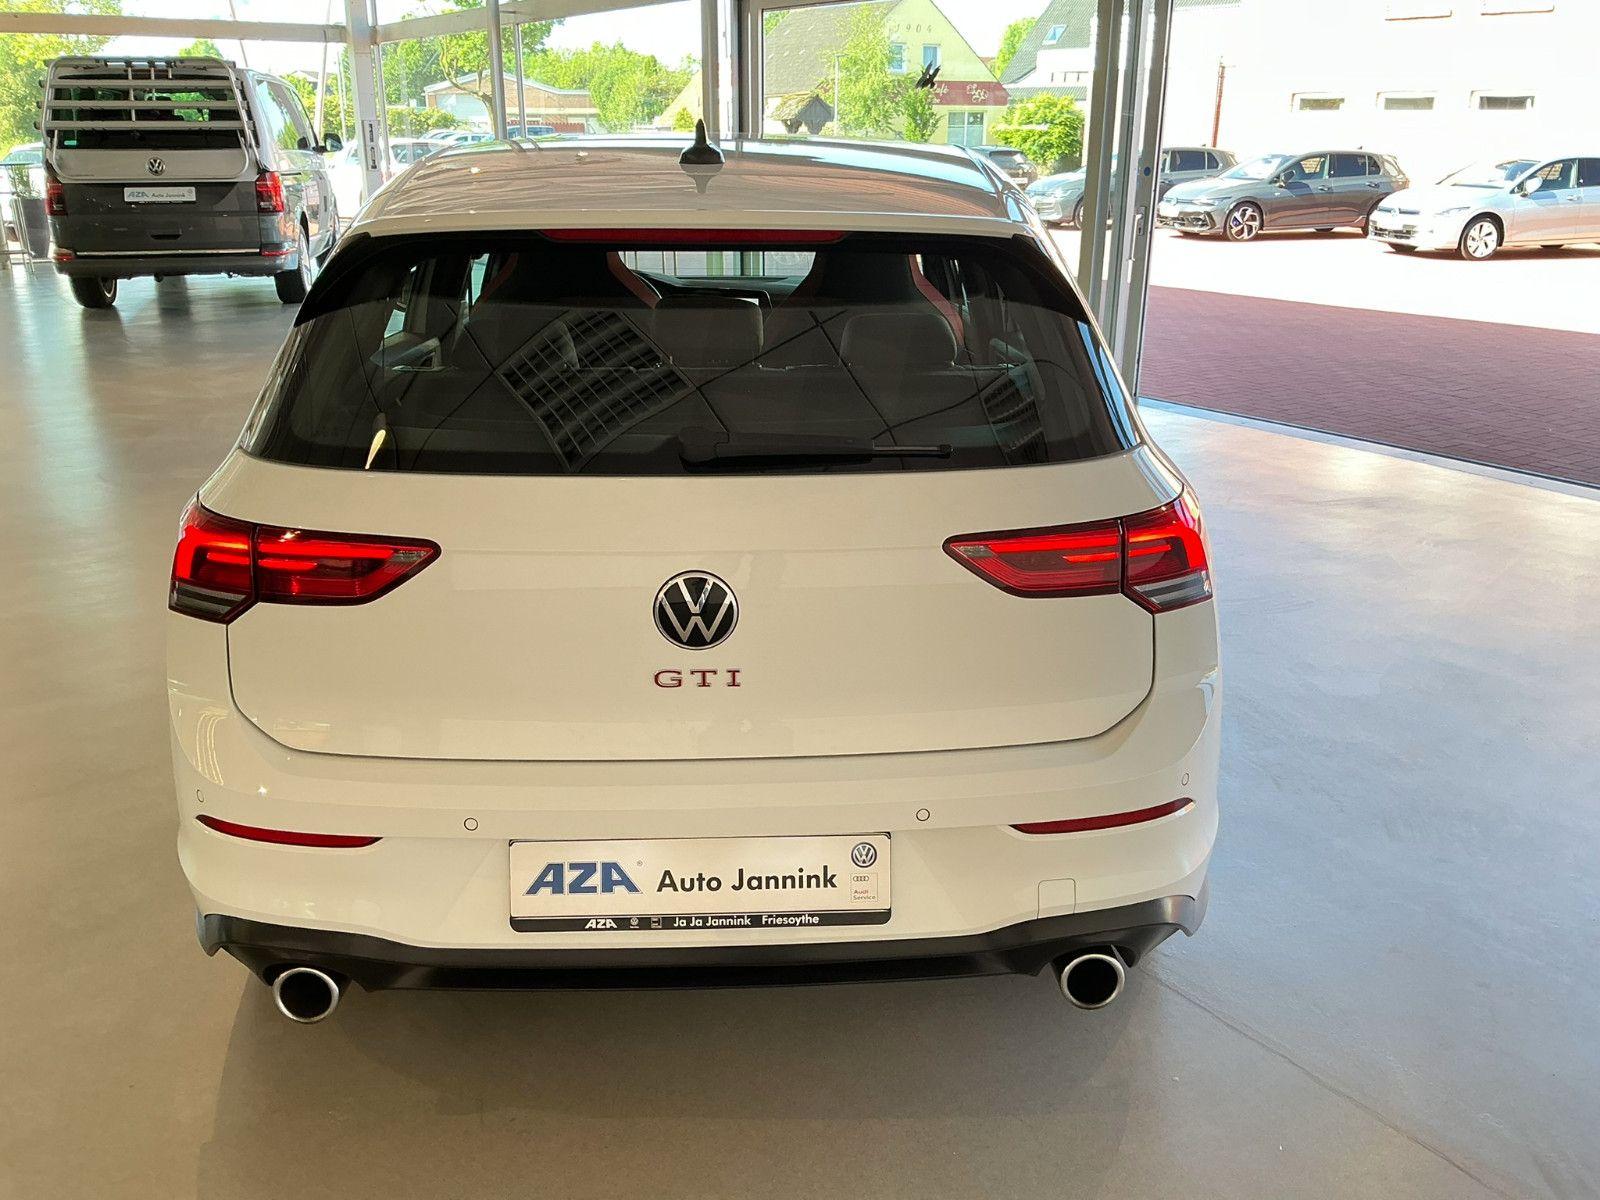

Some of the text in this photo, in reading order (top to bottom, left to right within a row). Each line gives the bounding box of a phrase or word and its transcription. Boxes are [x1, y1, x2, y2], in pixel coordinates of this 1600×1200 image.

[654, 669, 742, 688] GTI
[524, 861, 838, 895] AZA Auto Jannink
[584, 914, 820, 929] AZA Ja Ja Jannink Friesoythe
